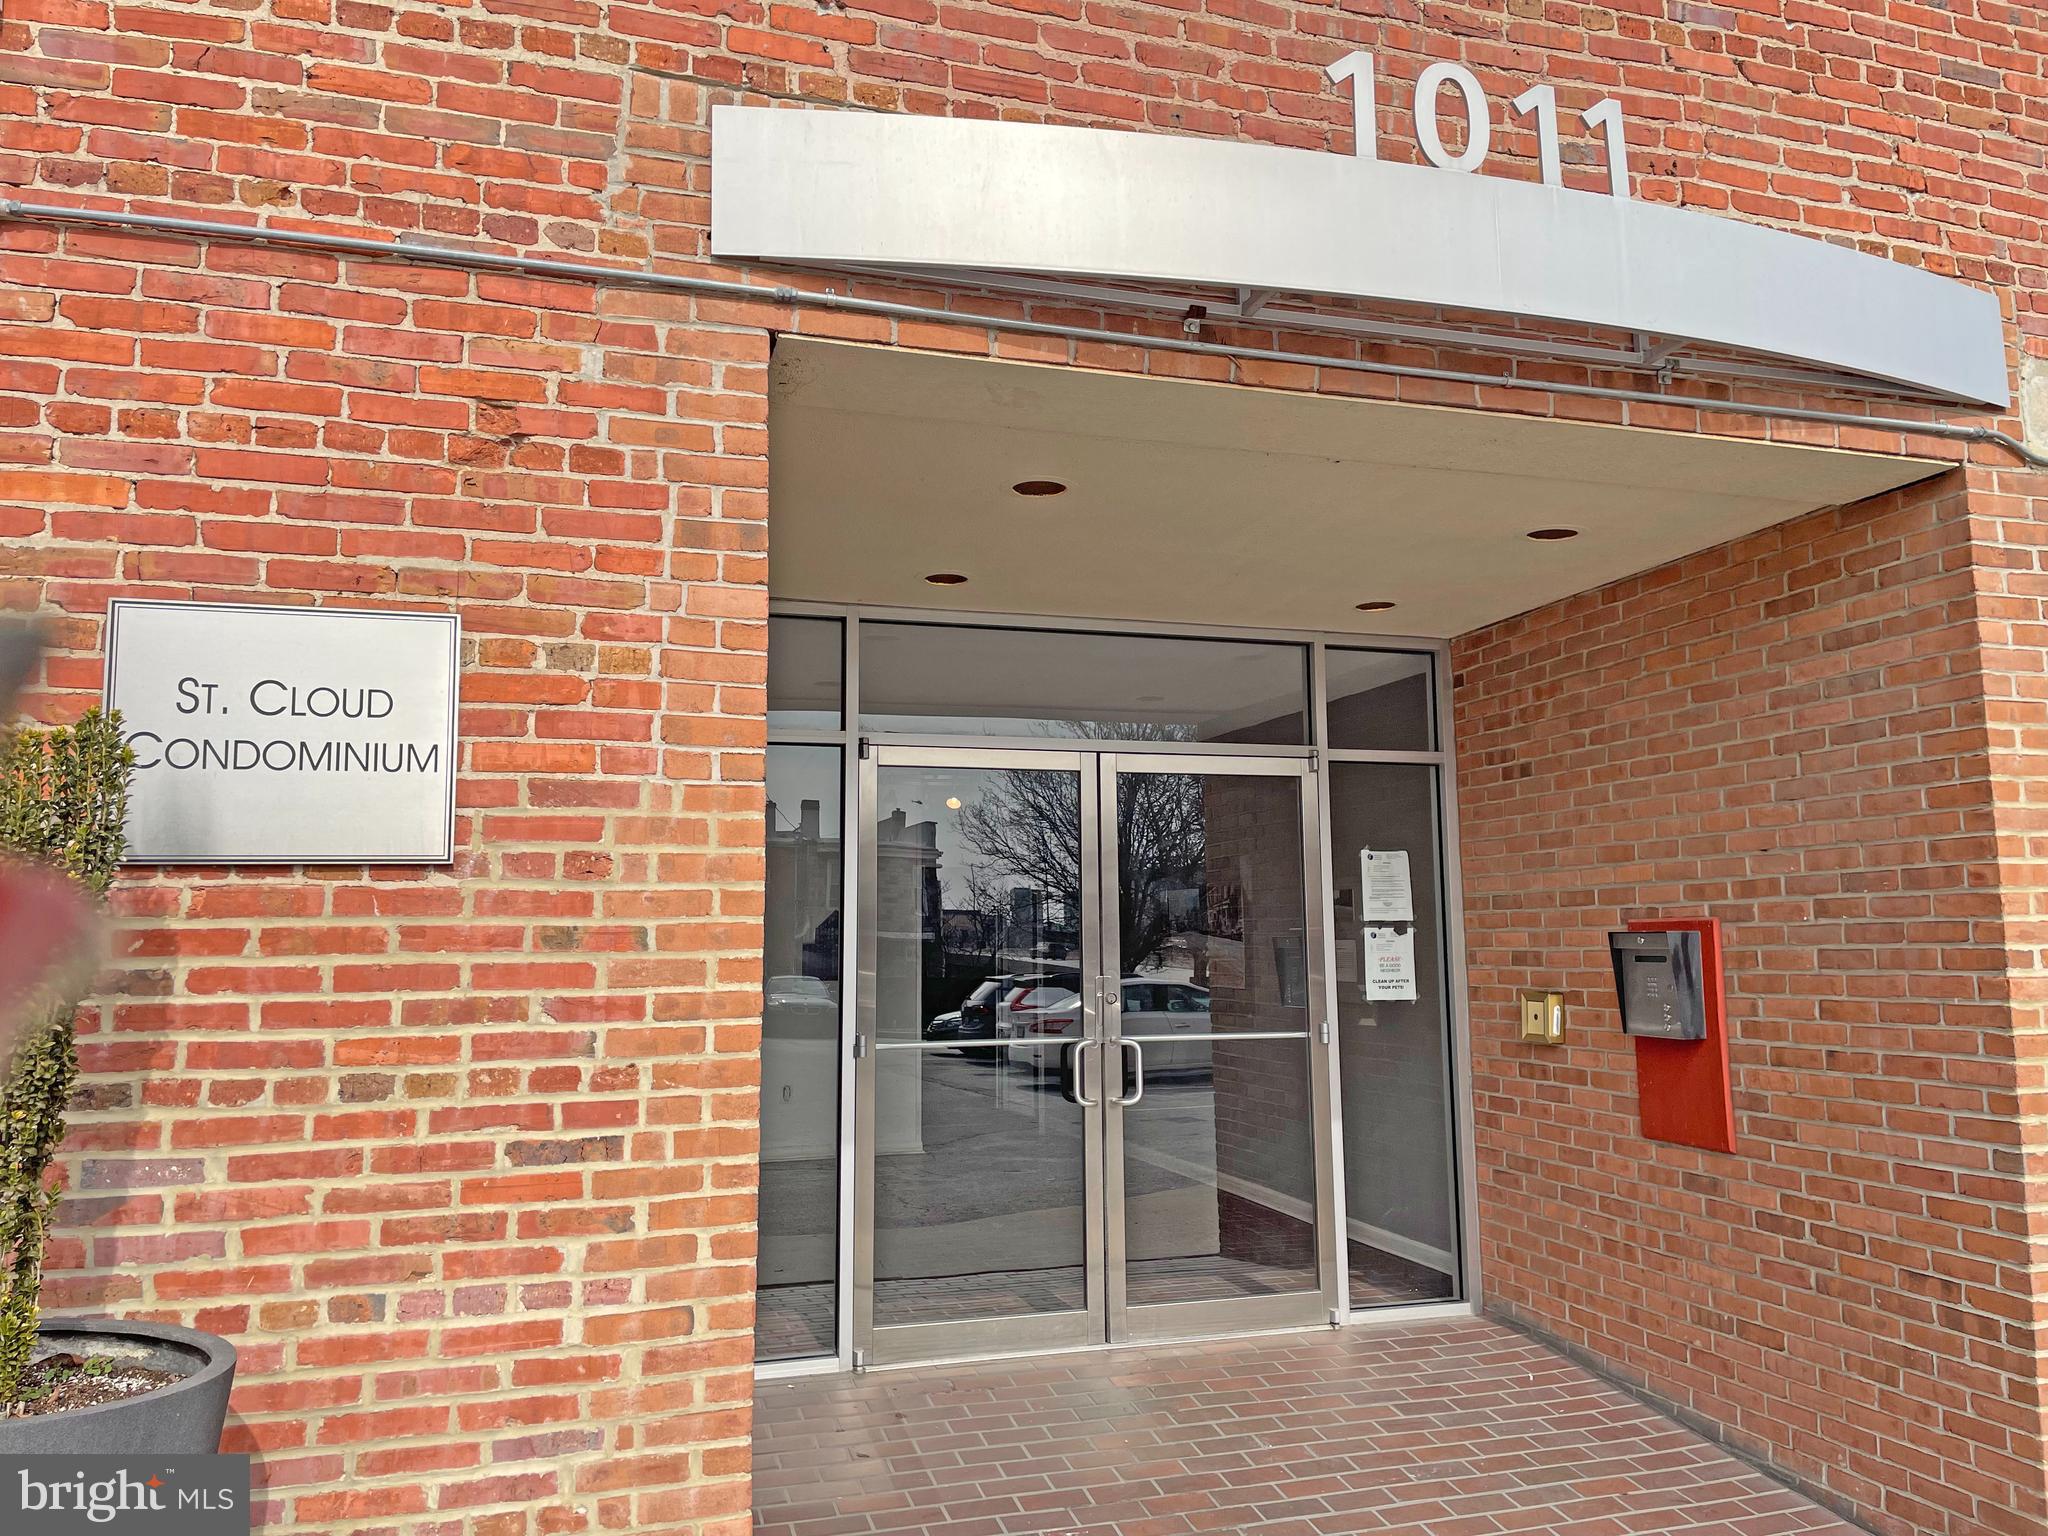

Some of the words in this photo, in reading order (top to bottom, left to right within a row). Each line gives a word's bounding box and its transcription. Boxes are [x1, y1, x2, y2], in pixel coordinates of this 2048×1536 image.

[1325, 50, 1631, 200] 1011
[175, 677, 228, 715] ST.
[249, 679, 394, 718] CLOUD
[125, 731, 439, 773] CONDOMINIUM
